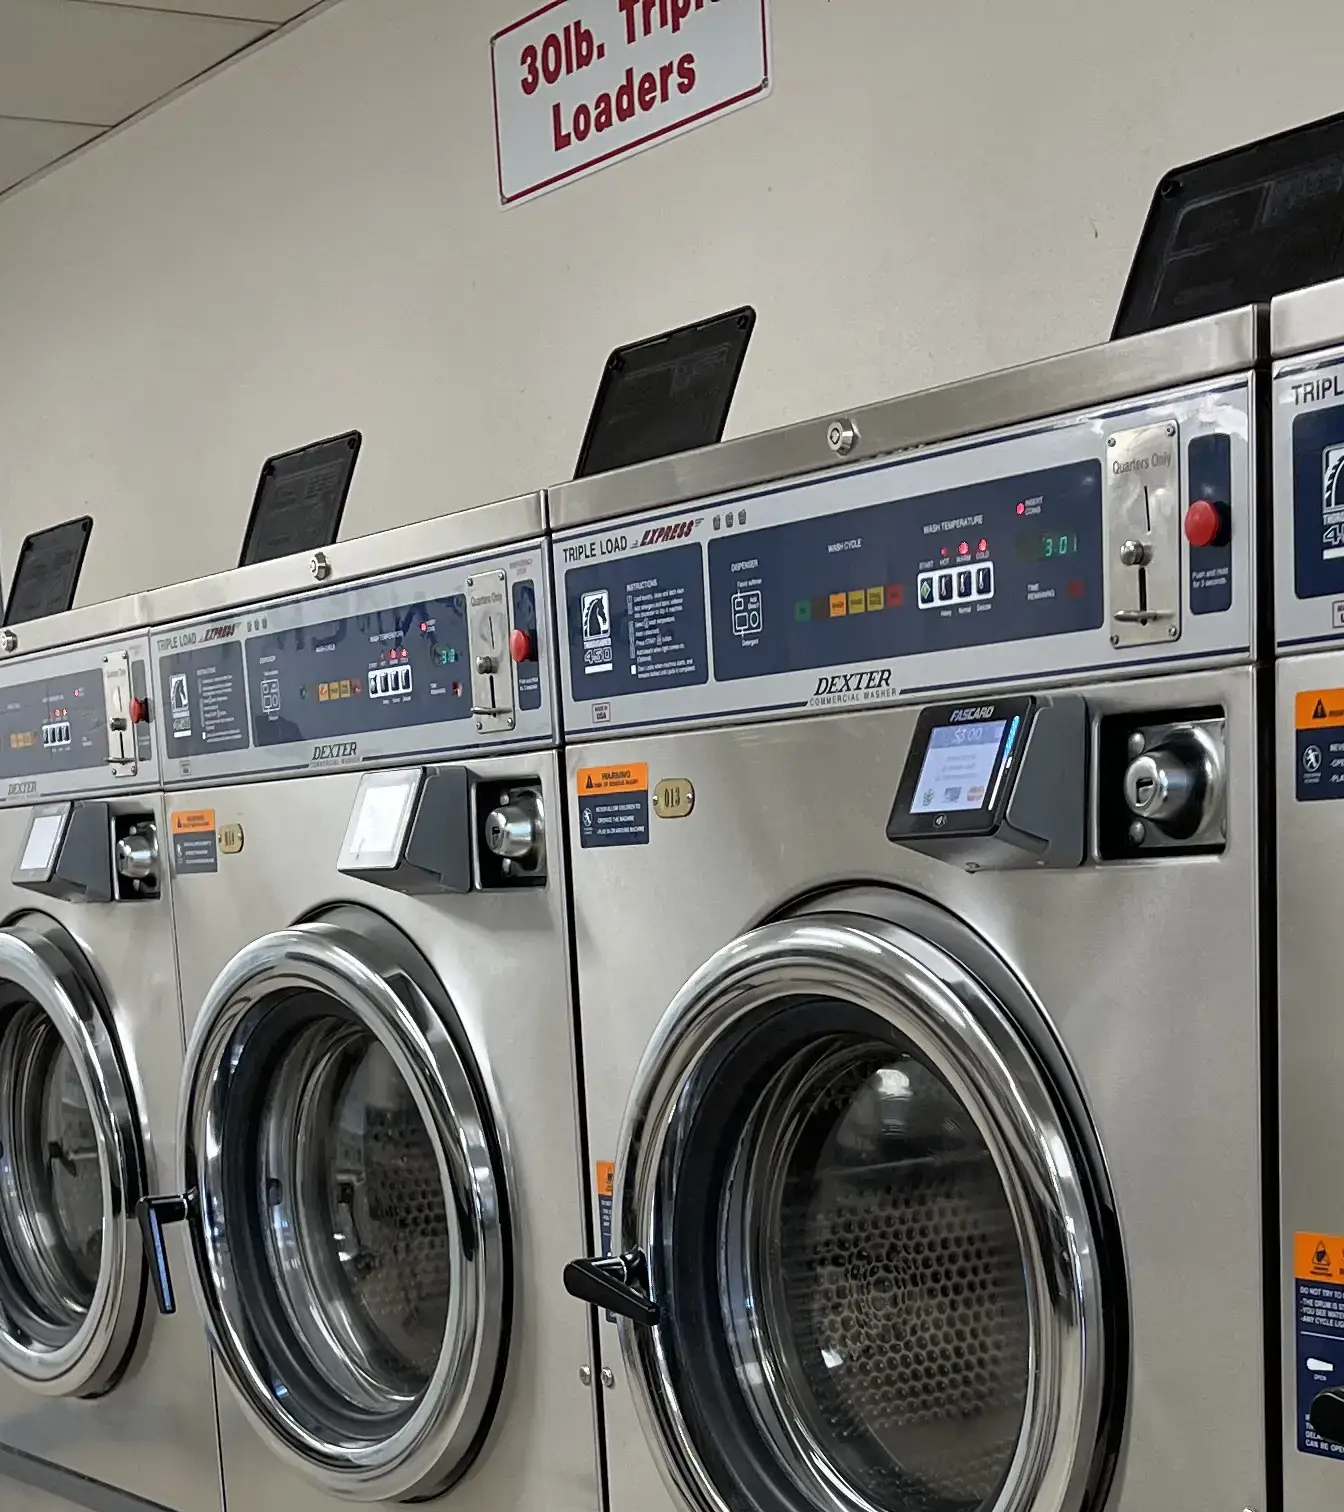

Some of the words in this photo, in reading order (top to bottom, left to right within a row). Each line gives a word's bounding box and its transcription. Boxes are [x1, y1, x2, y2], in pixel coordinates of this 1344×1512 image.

[520, 19, 606, 95] 30lb.
[619, 0, 720, 45] Trip
[551, 53, 696, 152] Loaders
[1112, 459, 1150, 475] Quarters
[1151, 453, 1172, 468] Only
[941, 514, 983, 531] TEMPERATURE
[640, 519, 696, 547] EXPRESS
[563, 543, 597, 563] TRIPLE
[600, 536, 628, 555] LOAD
[844, 538, 862, 550] CYCLE
[157, 636, 178, 652] TRIPLE
[179, 632, 196, 647] LOAD
[584, 647, 613, 664] 450
[814, 668, 892, 696] DEXTER
[809, 693, 859, 706] COMMERCIAL
[863, 687, 897, 699] WASHER
[949, 705, 995, 722] FASCARD
[312, 741, 358, 761] DEXTER
[1300, 1286, 1309, 1294] DO
[1309, 1287, 1321, 1295] NOT
[1322, 1289, 1333, 1297] TRY
[1334, 1290, 1342, 1299] TO
[1315, 1317, 1334, 1327] CYCLE
[1305, 1439, 1319, 1448] CAN
[1320, 1442, 1329, 1450] BE
